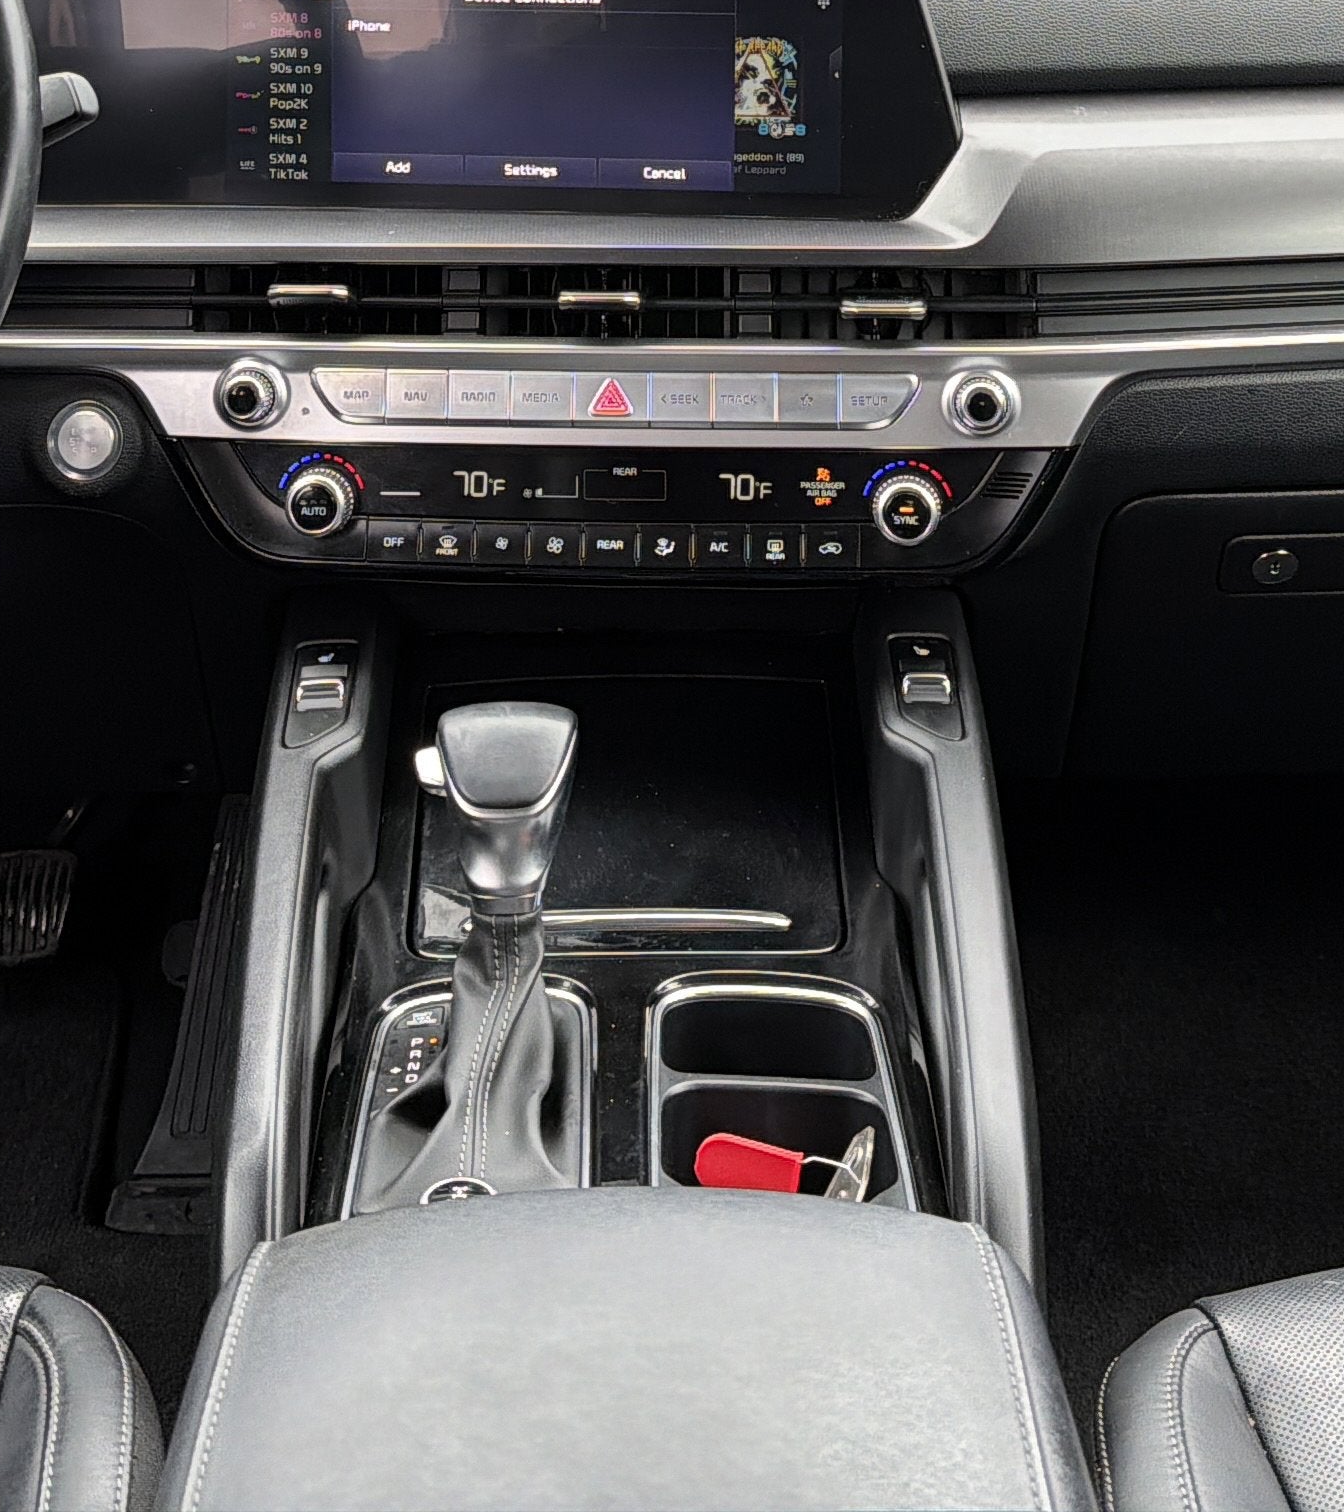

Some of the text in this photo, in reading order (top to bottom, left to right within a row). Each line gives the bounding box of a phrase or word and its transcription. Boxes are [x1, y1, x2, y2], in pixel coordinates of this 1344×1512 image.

[270, 12, 309, 23] SXM 8
[347, 19, 392, 32] iPhone
[295, 30, 311, 39] on
[314, 28, 322, 39] 8
[269, 47, 309, 59] SXM 9
[269, 62, 322, 74] 90s on 9
[269, 82, 313, 95] SXM 10
[269, 98, 309, 111] Pop2K
[269, 118, 297, 130] SXM
[299, 118, 308, 130] 2
[269, 133, 302, 145] Hits 1
[269, 153, 308, 165] SXM 4
[269, 168, 309, 180] TikTok
[385, 160, 687, 181] Add Settings Cancel
[744, 165, 787, 175] Leppard
[343, 390, 370, 401] MAP
[404, 391, 428, 402] NAV
[460, 391, 497, 403] RADIO
[521, 392, 560, 403] MEDIA
[669, 393, 699, 405] SEEK
[719, 393, 757, 405] TRACK
[850, 395, 888, 407] SETUP
[612, 467, 638, 477] REAR
[799, 481, 846, 490] PASSENGER
[805, 489, 837, 498] AIR BAG
[814, 497, 832, 506] OFF
[300, 506, 327, 517] AUTO
[893, 515, 920, 526] SYNC
[383, 536, 405, 548] OFF
[596, 539, 625, 550] REAR
[709, 541, 729, 553] A/C
[435, 548, 460, 556] FRONT
[765, 552, 786, 561] REAR
[410, 1037, 424, 1048] P
[409, 1049, 422, 1059] R
[407, 1061, 421, 1071] N
[405, 1073, 418, 1084] D
